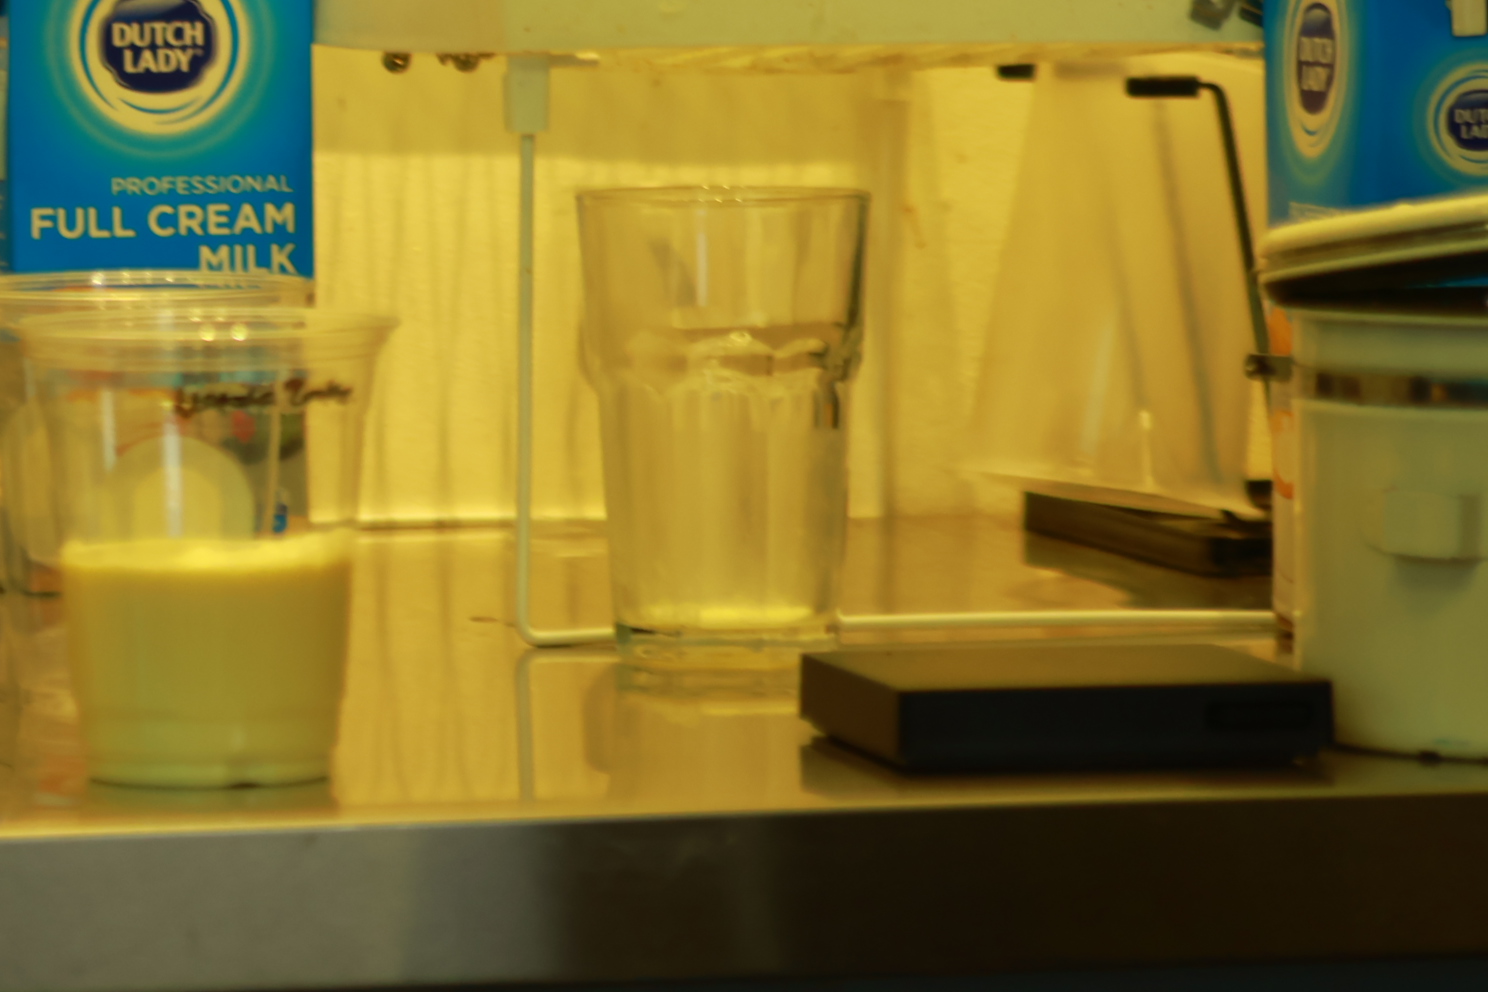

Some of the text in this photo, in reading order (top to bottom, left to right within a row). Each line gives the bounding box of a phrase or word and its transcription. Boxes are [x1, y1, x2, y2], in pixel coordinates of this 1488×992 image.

[112, 21, 204, 47] DUTCH
[123, 48, 193, 73] LADY
[1454, 109, 1488, 123] DUT
[111, 174, 294, 195] PROFESSIONAL
[30, 207, 137, 240] FULL
[147, 202, 296, 237] CREAM
[199, 243, 299, 275] MILK
